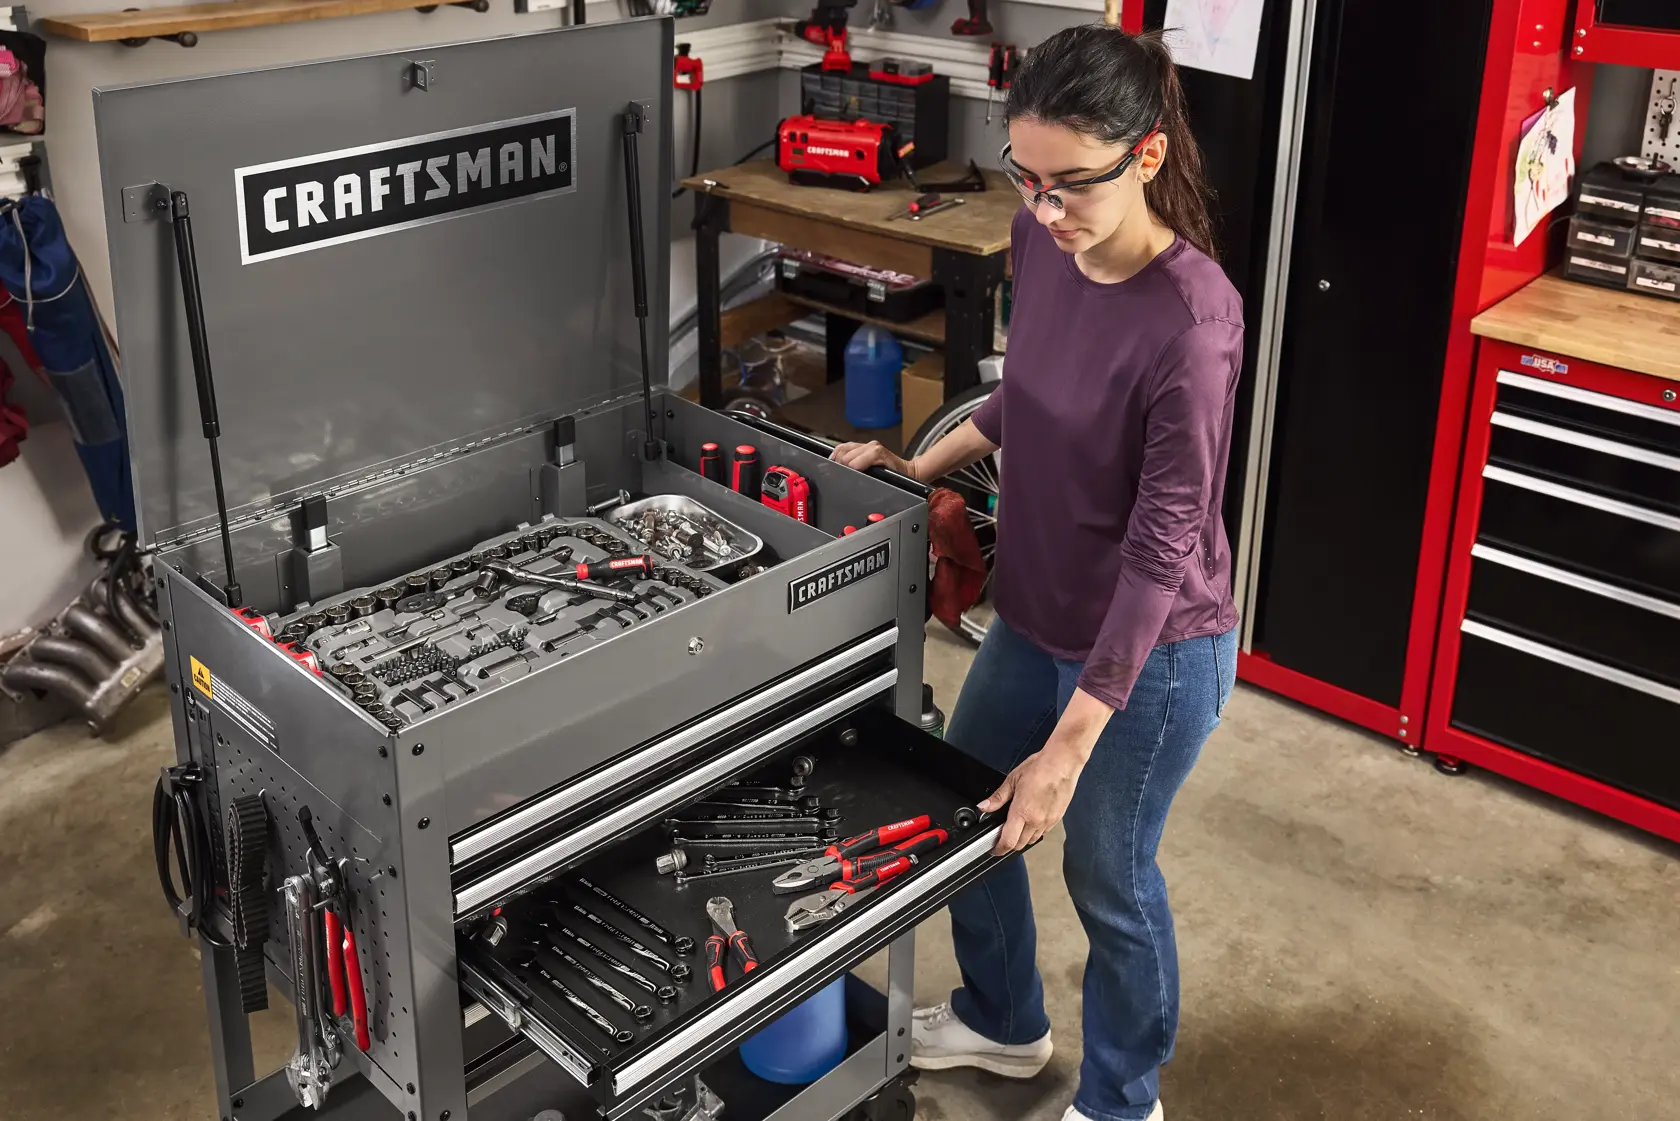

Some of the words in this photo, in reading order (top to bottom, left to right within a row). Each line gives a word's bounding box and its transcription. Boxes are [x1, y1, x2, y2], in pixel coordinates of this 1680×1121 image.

[807, 146, 849, 157] CRAFTSMAN
[1534, 357, 1556, 369] USA
[611, 559, 643, 567] CRAFTSMAN
[798, 550, 885, 603] CRAFTSMAN
[193, 673, 210, 692] CAUTION
[887, 819, 915, 831] CRAFTSMAN
